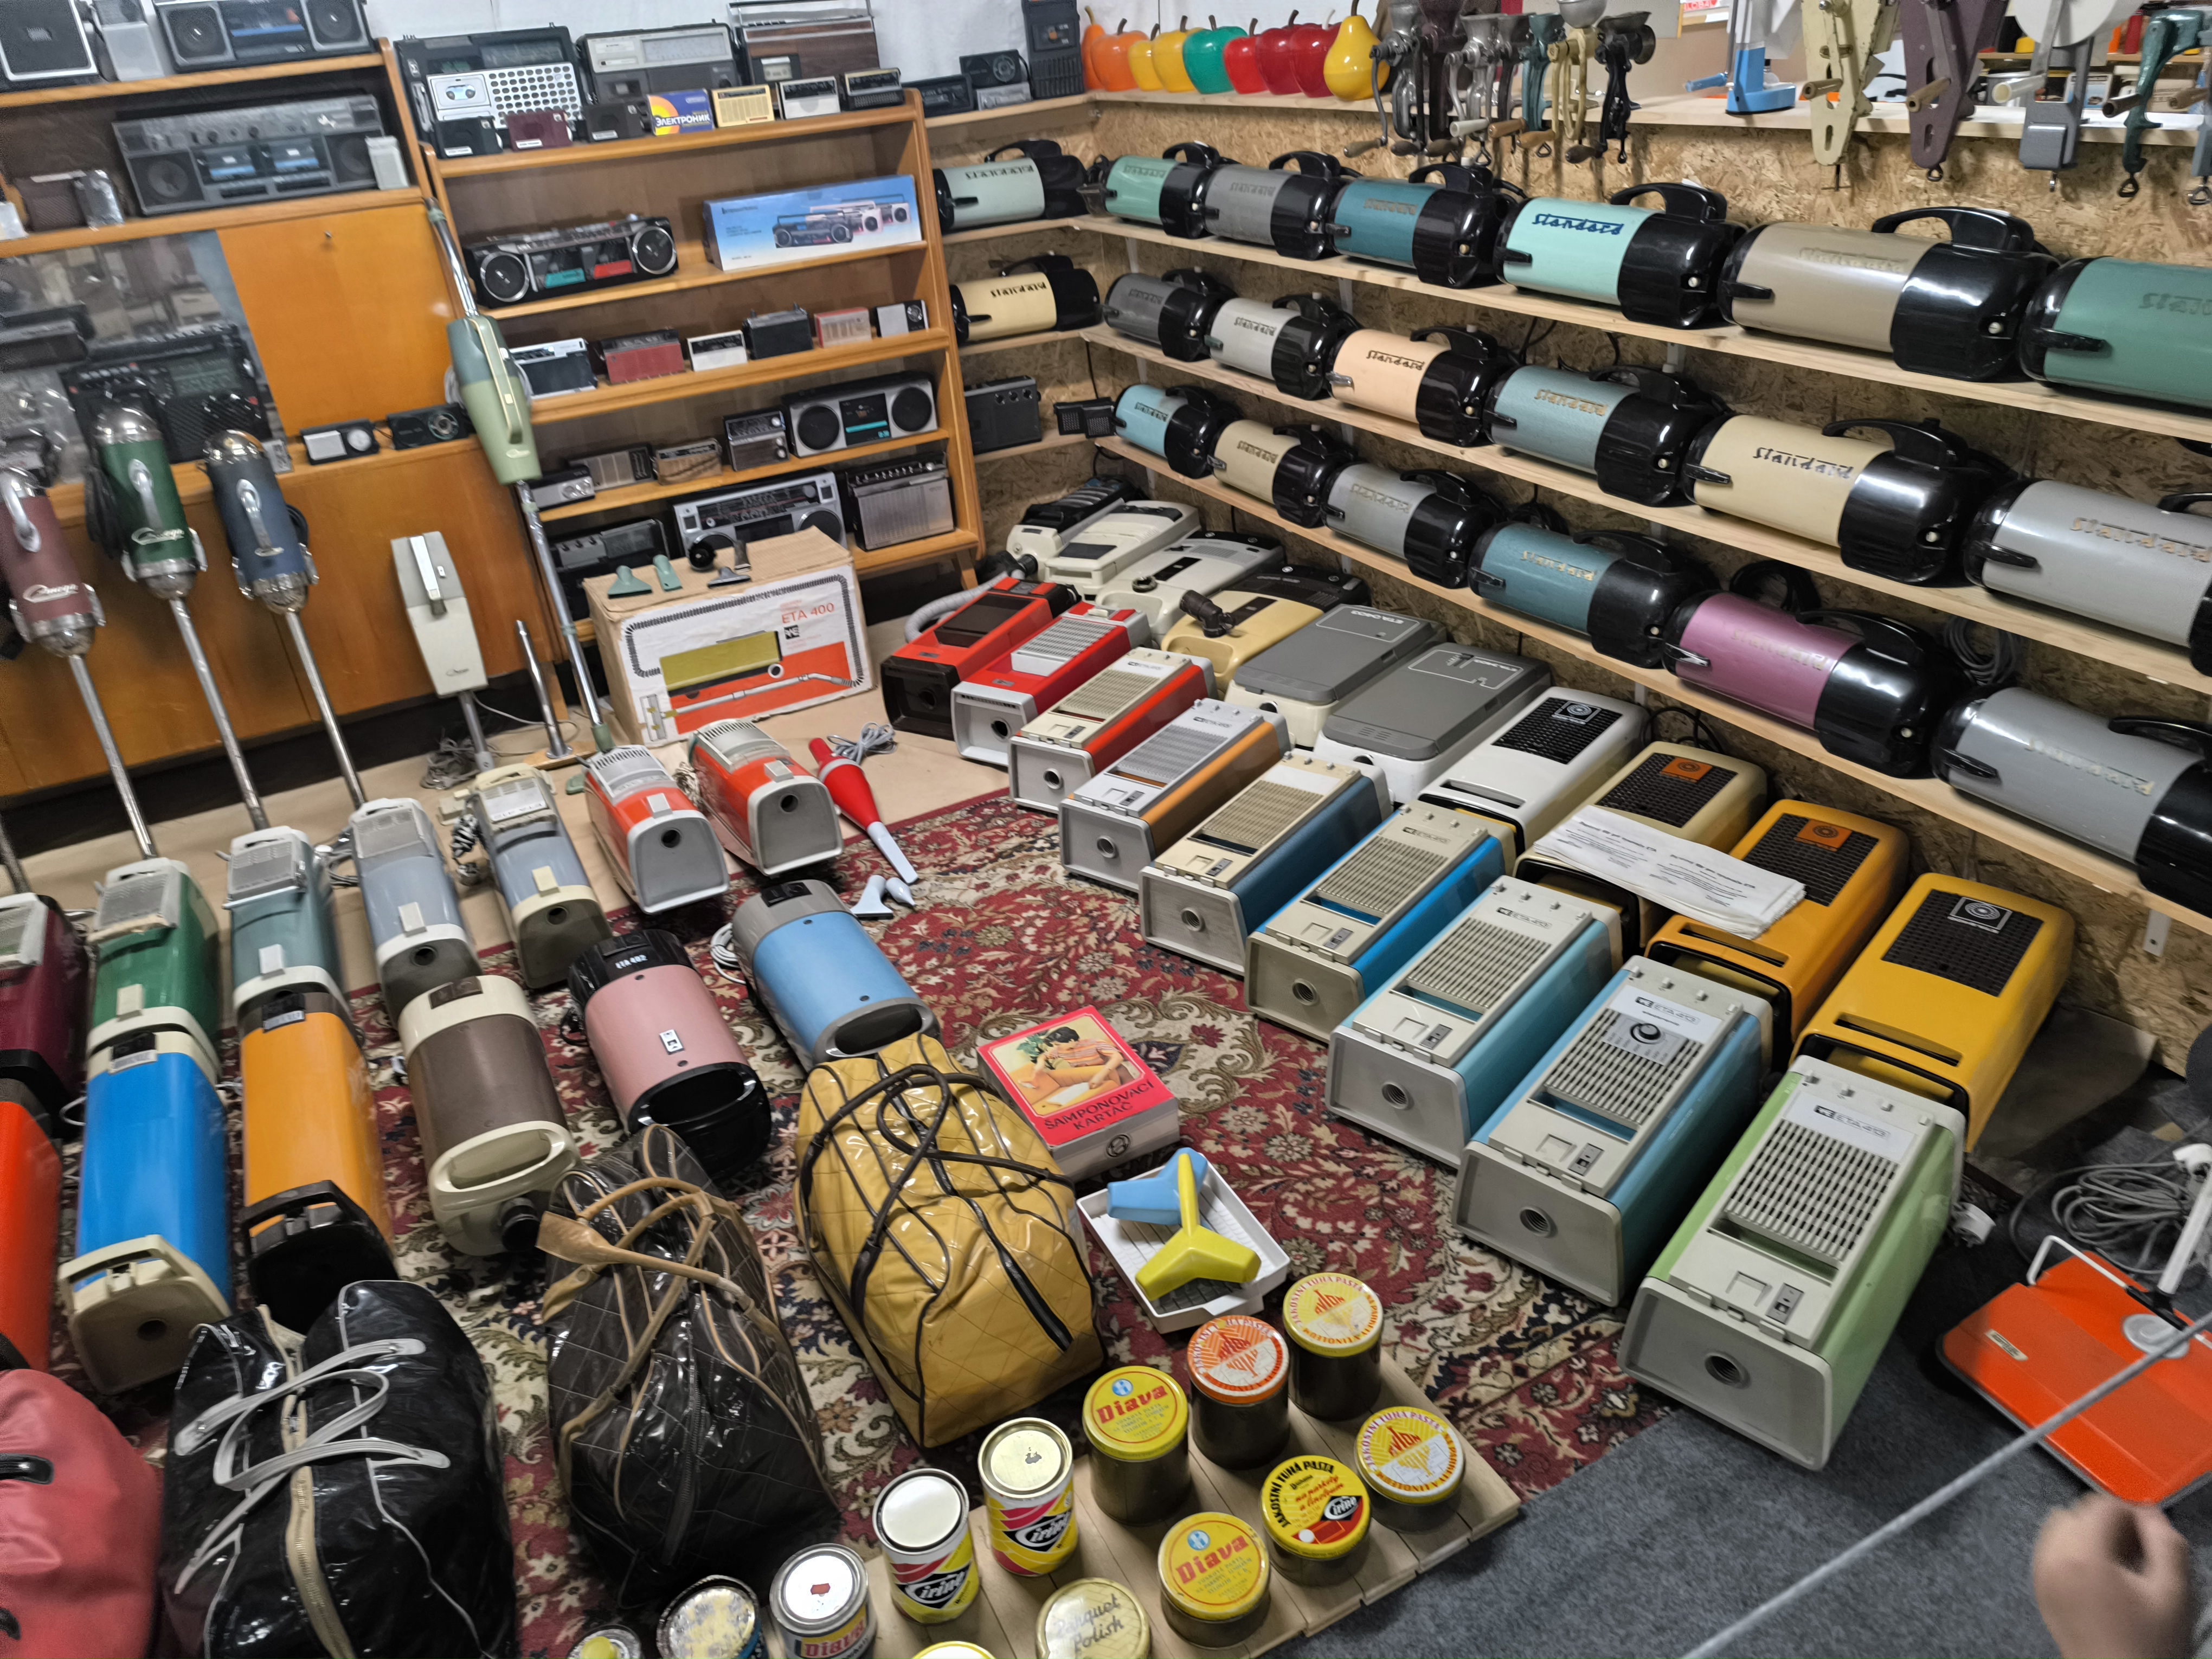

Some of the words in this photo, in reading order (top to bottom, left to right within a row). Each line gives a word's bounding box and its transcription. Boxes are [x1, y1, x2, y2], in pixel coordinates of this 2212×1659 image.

[781, 610, 808, 624] ETA
[810, 602, 835, 616] 400
[1654, 1004, 1675, 1015] ETA
[1044, 1078, 1155, 1129] ŠAMPONOVACÍ
[1836, 1114, 1862, 1128] ETA
[1335, 1276, 1363, 1293] PASTA
[1314, 1289, 1346, 1316] AVION
[1096, 1385, 1168, 1425] Diava
[1410, 1411, 1440, 1430] PASTA
[1386, 1425, 1422, 1458] AVION
[1302, 1461, 1335, 1475] PASTA
[1175, 1535, 1250, 1585] Diava
